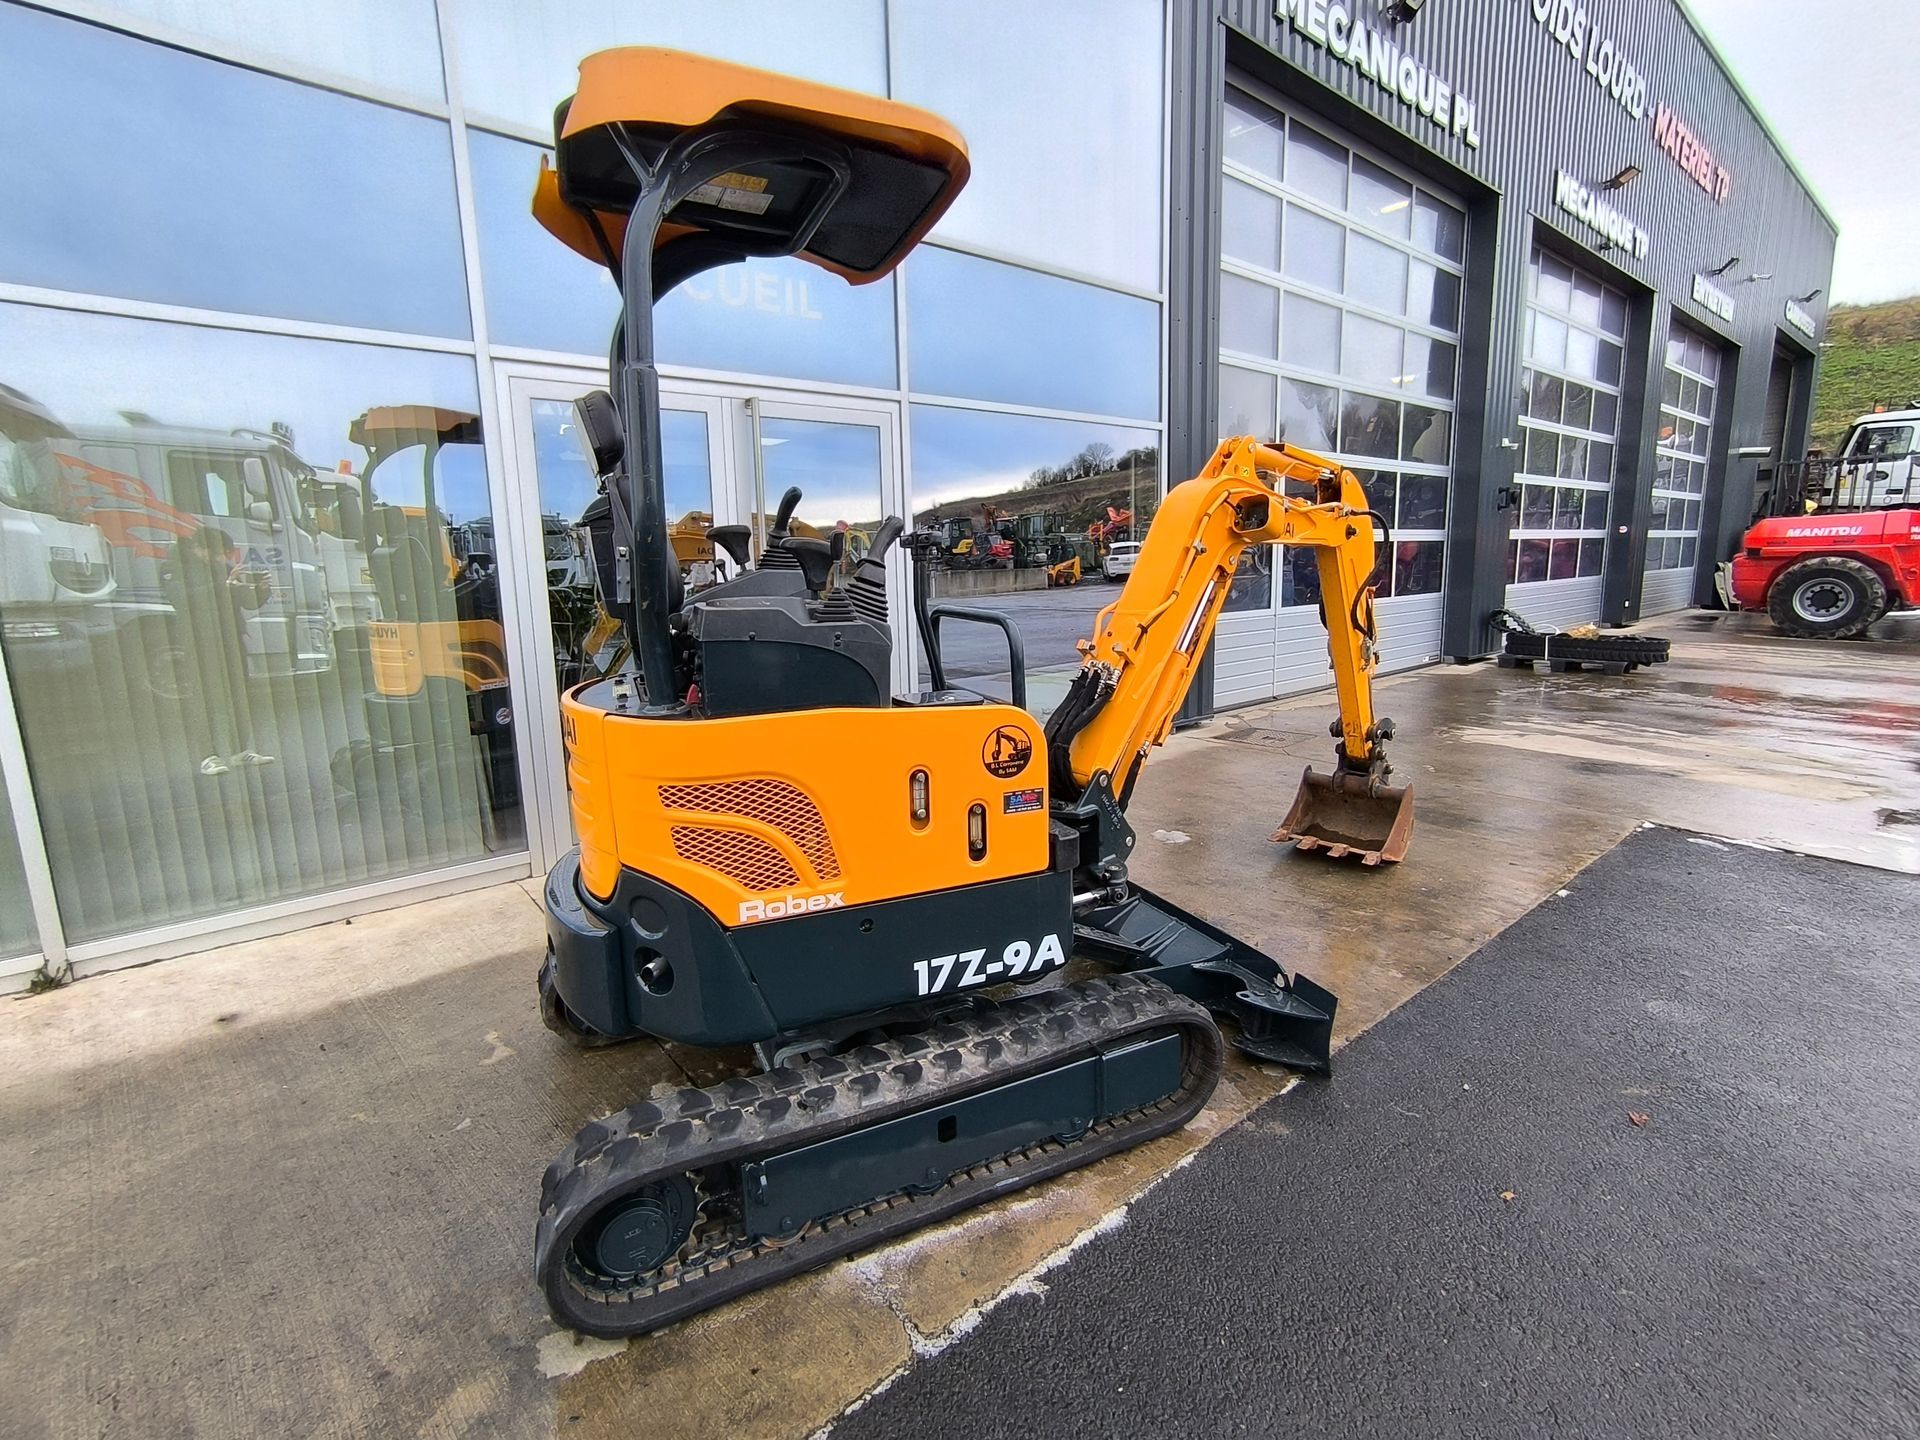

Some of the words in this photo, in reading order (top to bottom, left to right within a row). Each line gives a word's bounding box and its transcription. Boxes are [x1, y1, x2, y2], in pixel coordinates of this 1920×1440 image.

[1586, 25, 1645, 120] LOURD
[1453, 91, 1480, 149] PL
[1555, 168, 1634, 254] MECANIQUE
[1786, 526, 1863, 537] MANITOU
[739, 891, 846, 923] Robex
[913, 933, 1066, 996] 17Z-9A
